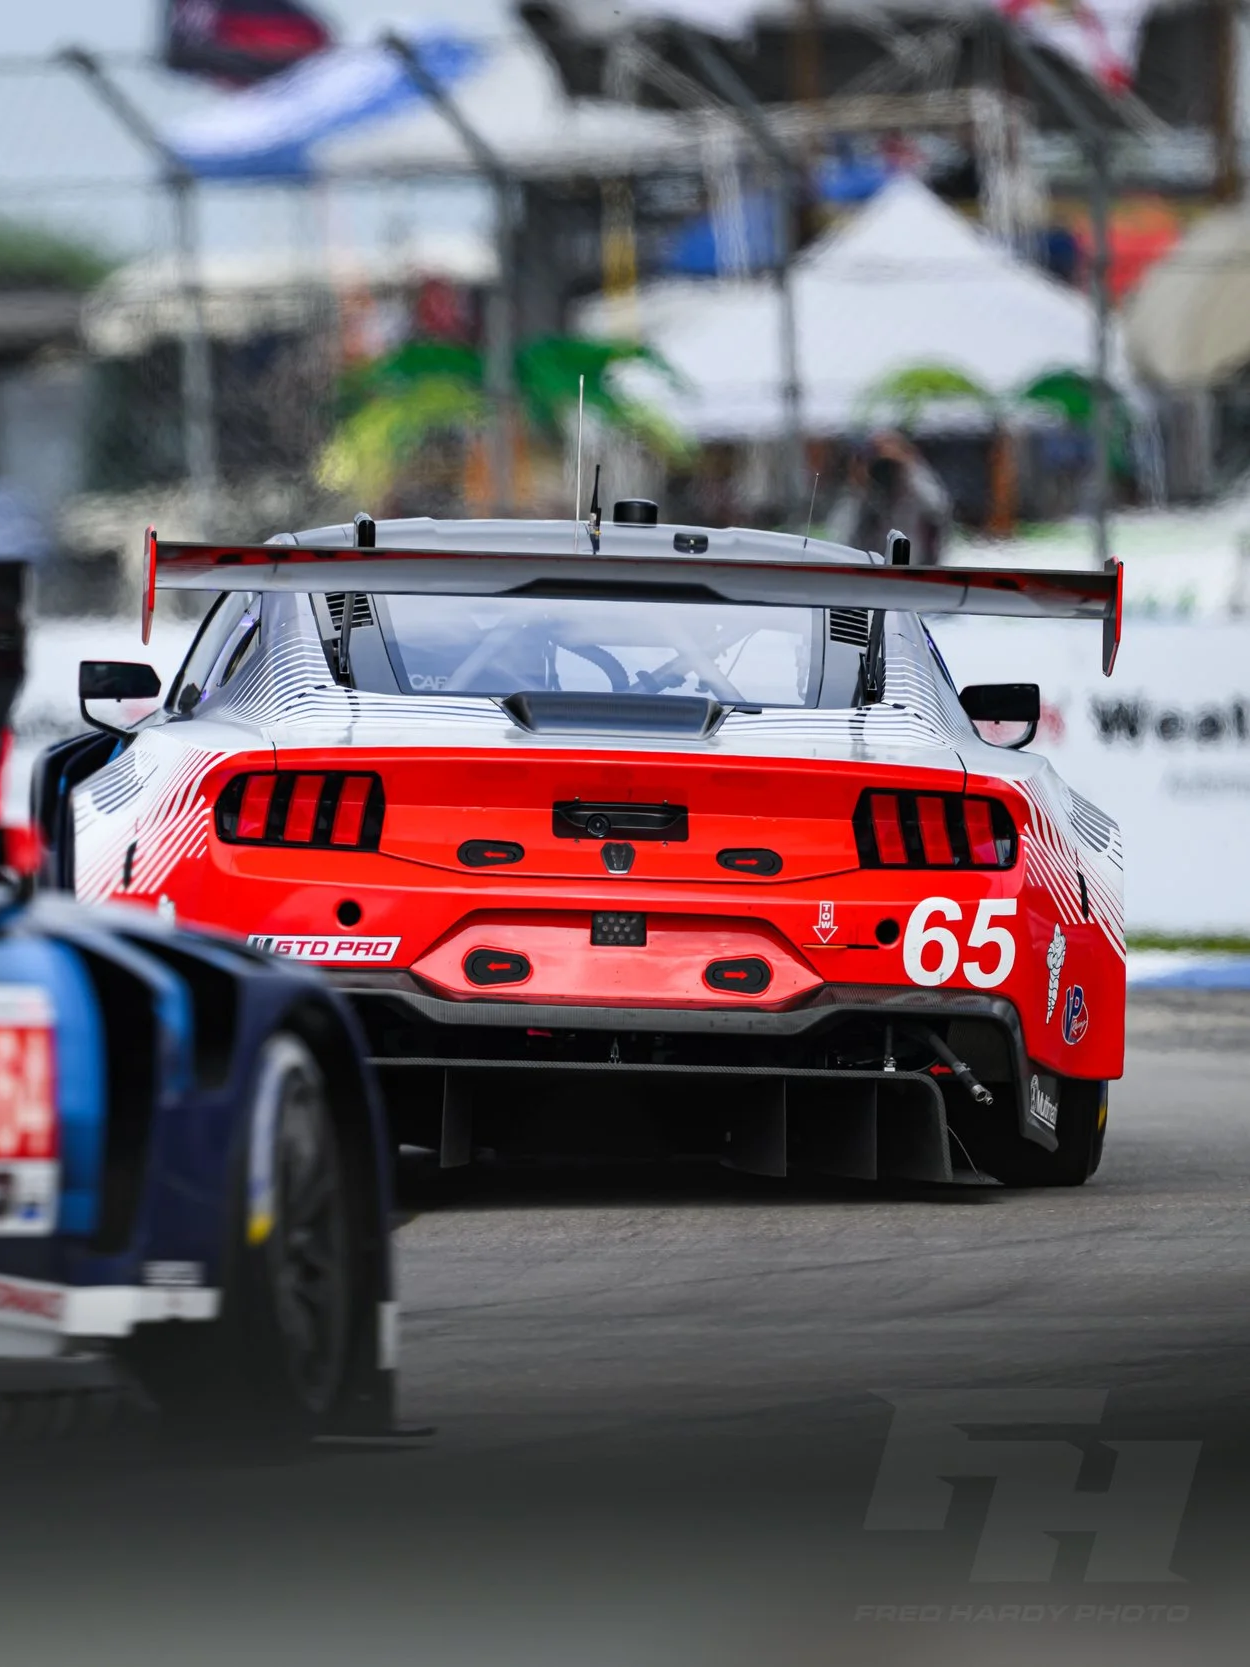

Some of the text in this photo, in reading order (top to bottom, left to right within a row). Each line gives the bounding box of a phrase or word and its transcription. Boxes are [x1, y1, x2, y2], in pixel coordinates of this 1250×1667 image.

[821, 904, 831, 928] TOW
[275, 940, 392, 957] GTD PRO
[903, 897, 1017, 988] 65
